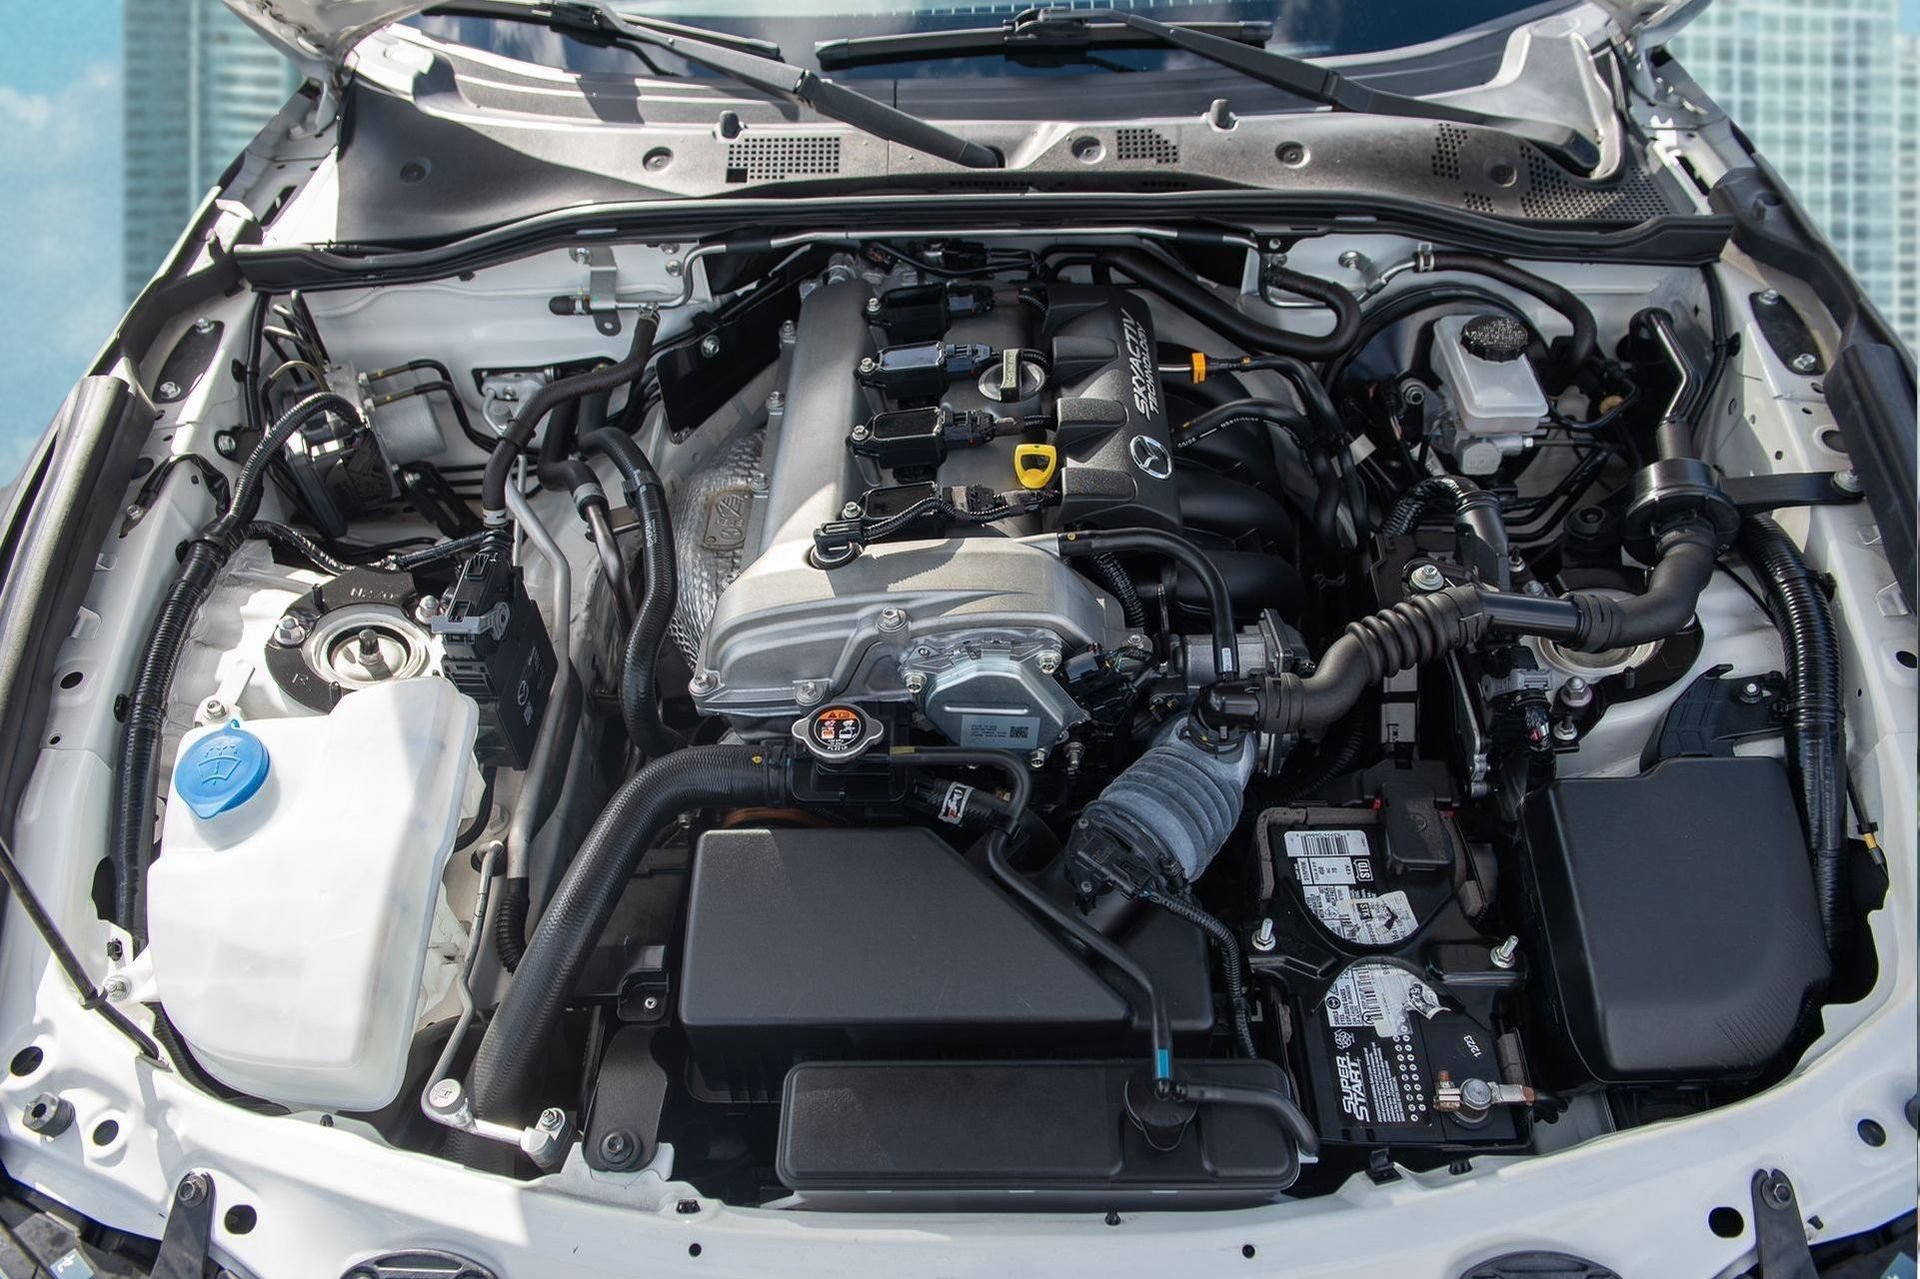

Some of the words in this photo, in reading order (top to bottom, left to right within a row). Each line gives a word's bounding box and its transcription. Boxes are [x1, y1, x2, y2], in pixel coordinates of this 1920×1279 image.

[1121, 307, 1150, 421] SKYACTIV
[1137, 321, 1159, 415] TECHNOLOGY
[1463, 1034, 1482, 1058] 12/23
[1336, 1056, 1356, 1114] SUPER
[1346, 1056, 1370, 1122] START
